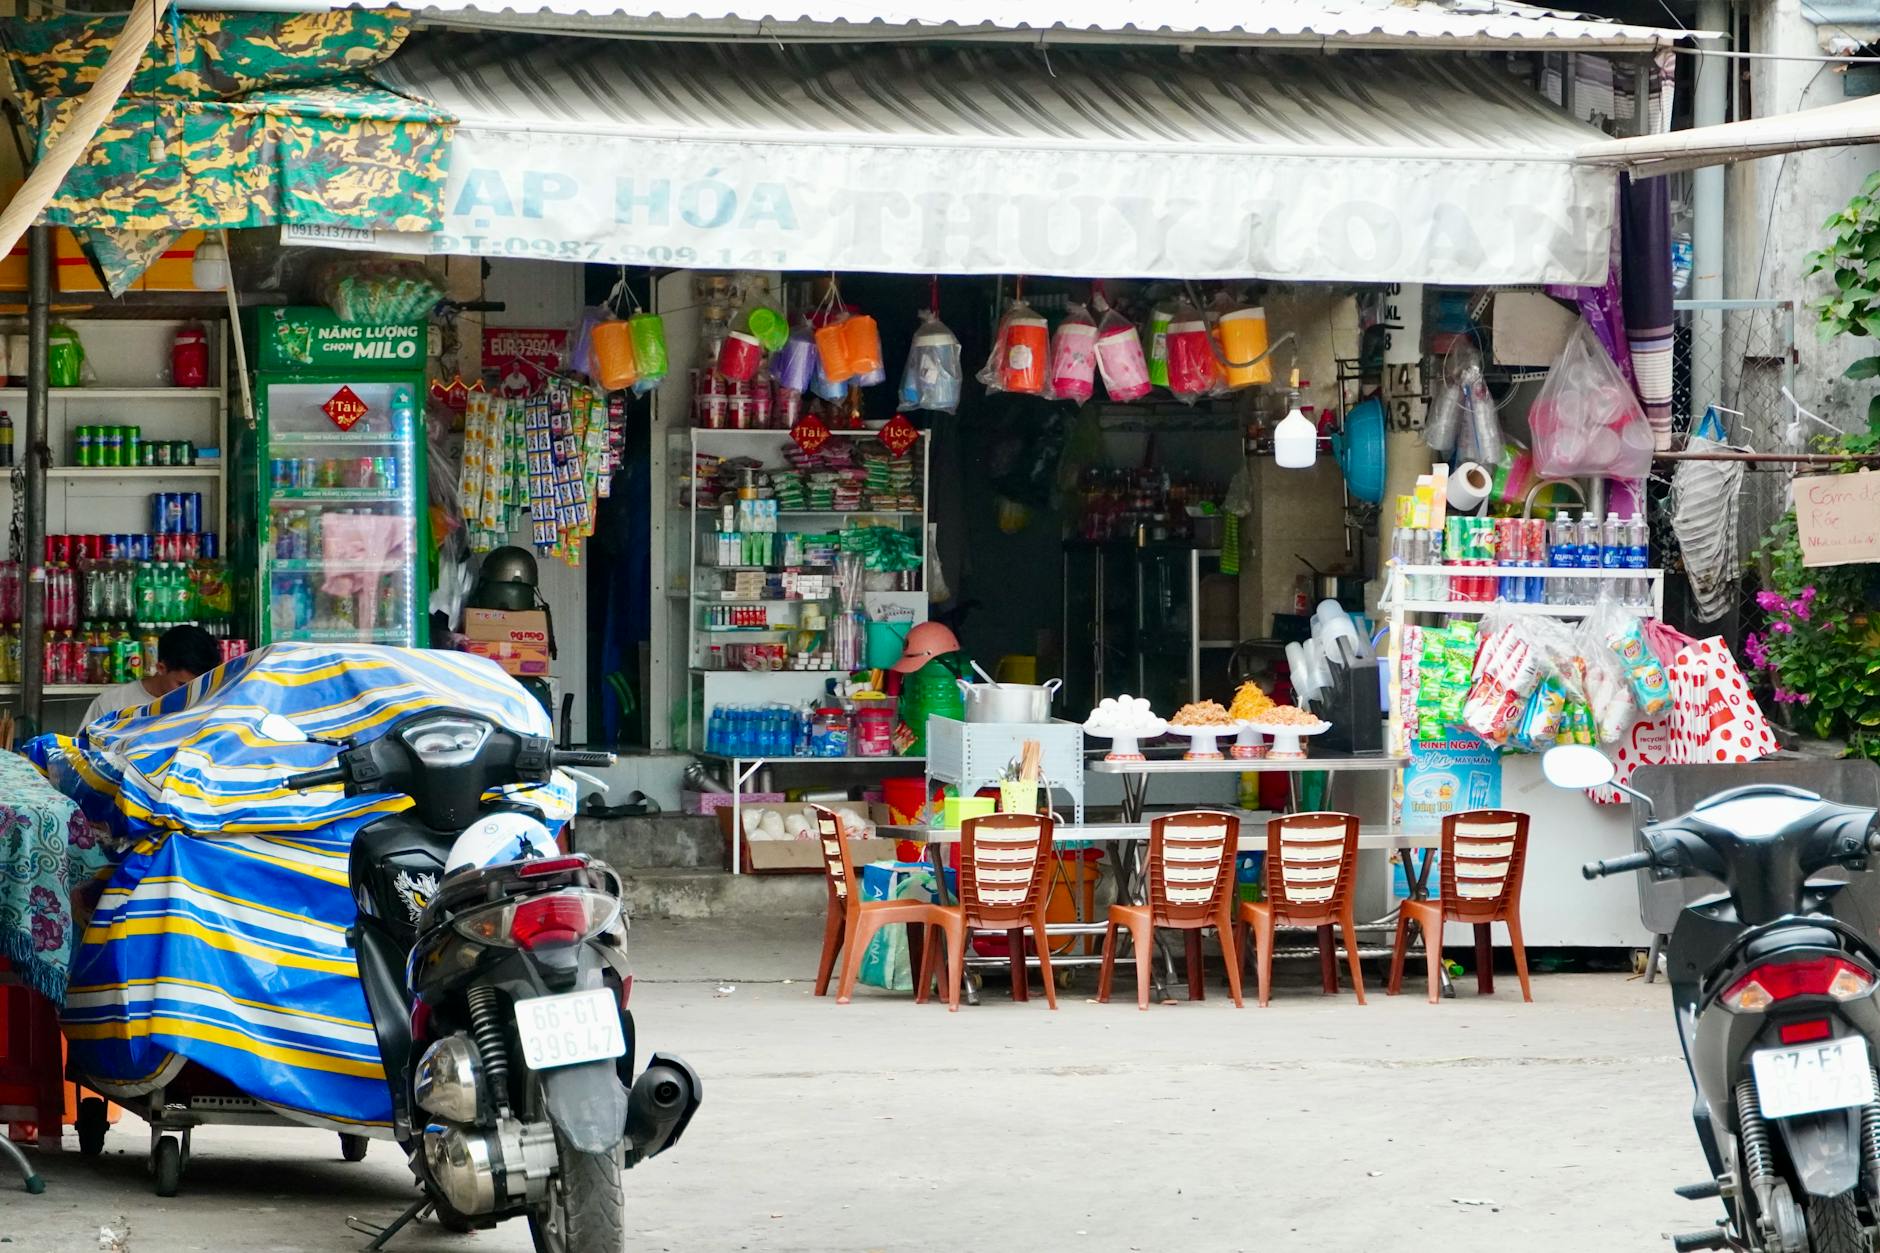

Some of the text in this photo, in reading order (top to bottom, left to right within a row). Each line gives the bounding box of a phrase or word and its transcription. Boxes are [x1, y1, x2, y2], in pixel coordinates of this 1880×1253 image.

[614, 166, 799, 230] HÓA
[318, 325, 419, 341] NĂNG LƯỢNG
[323, 341, 416, 360] CHỌN MILO
[335, 400, 358, 413] Tài
[1450, 740, 1481, 750] NGAY
[1647, 743, 1662, 751] bag
[532, 996, 601, 1031] 66-G1
